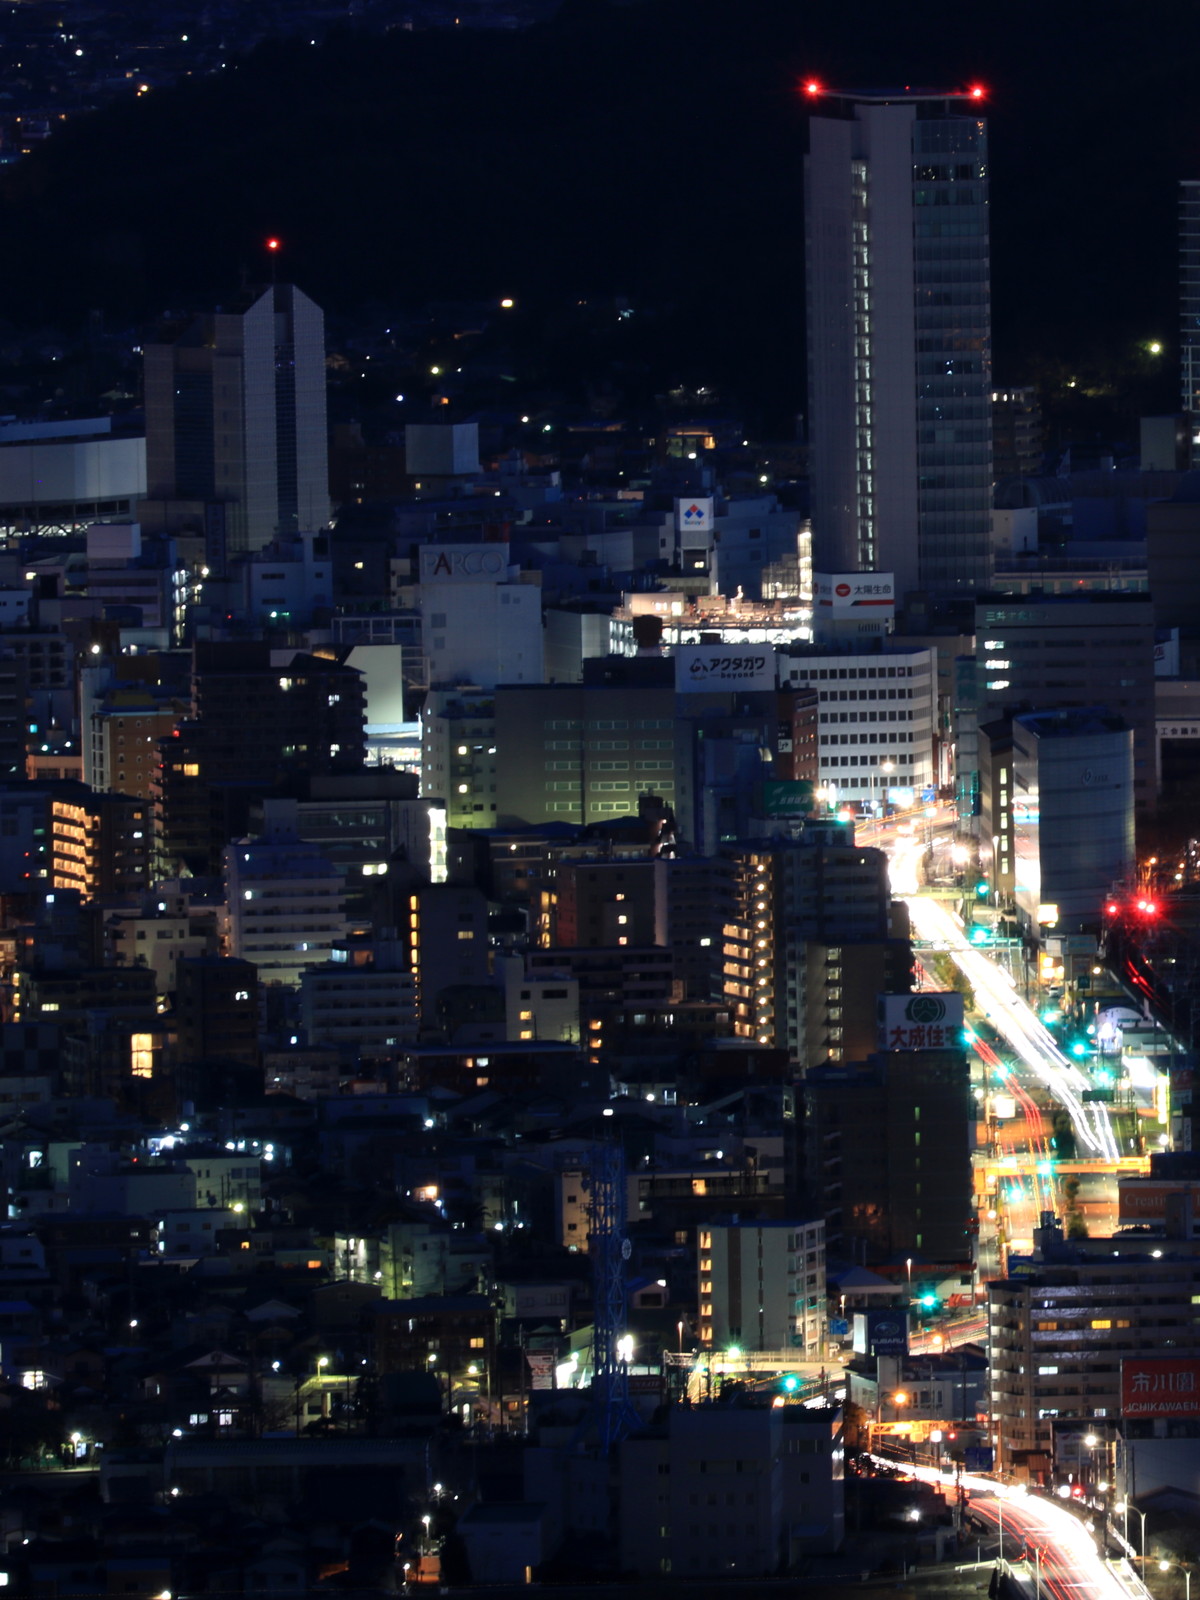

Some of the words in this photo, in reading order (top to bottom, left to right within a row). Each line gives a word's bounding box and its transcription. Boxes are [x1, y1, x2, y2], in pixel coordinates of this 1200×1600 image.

[423, 551, 505, 576] PARCO
[854, 584, 892, 595] 太陽生命
[709, 656, 765, 671] アクタガワ
[720, 671, 755, 679] beyond
[1154, 726, 1199, 736] 工会議所
[1124, 1193, 1168, 1208] Creati
[871, 1337, 905, 1345] SUBARU
[1131, 1371, 1195, 1393] 市川園
[1127, 1401, 1200, 1413] ICHIKAWAEN
